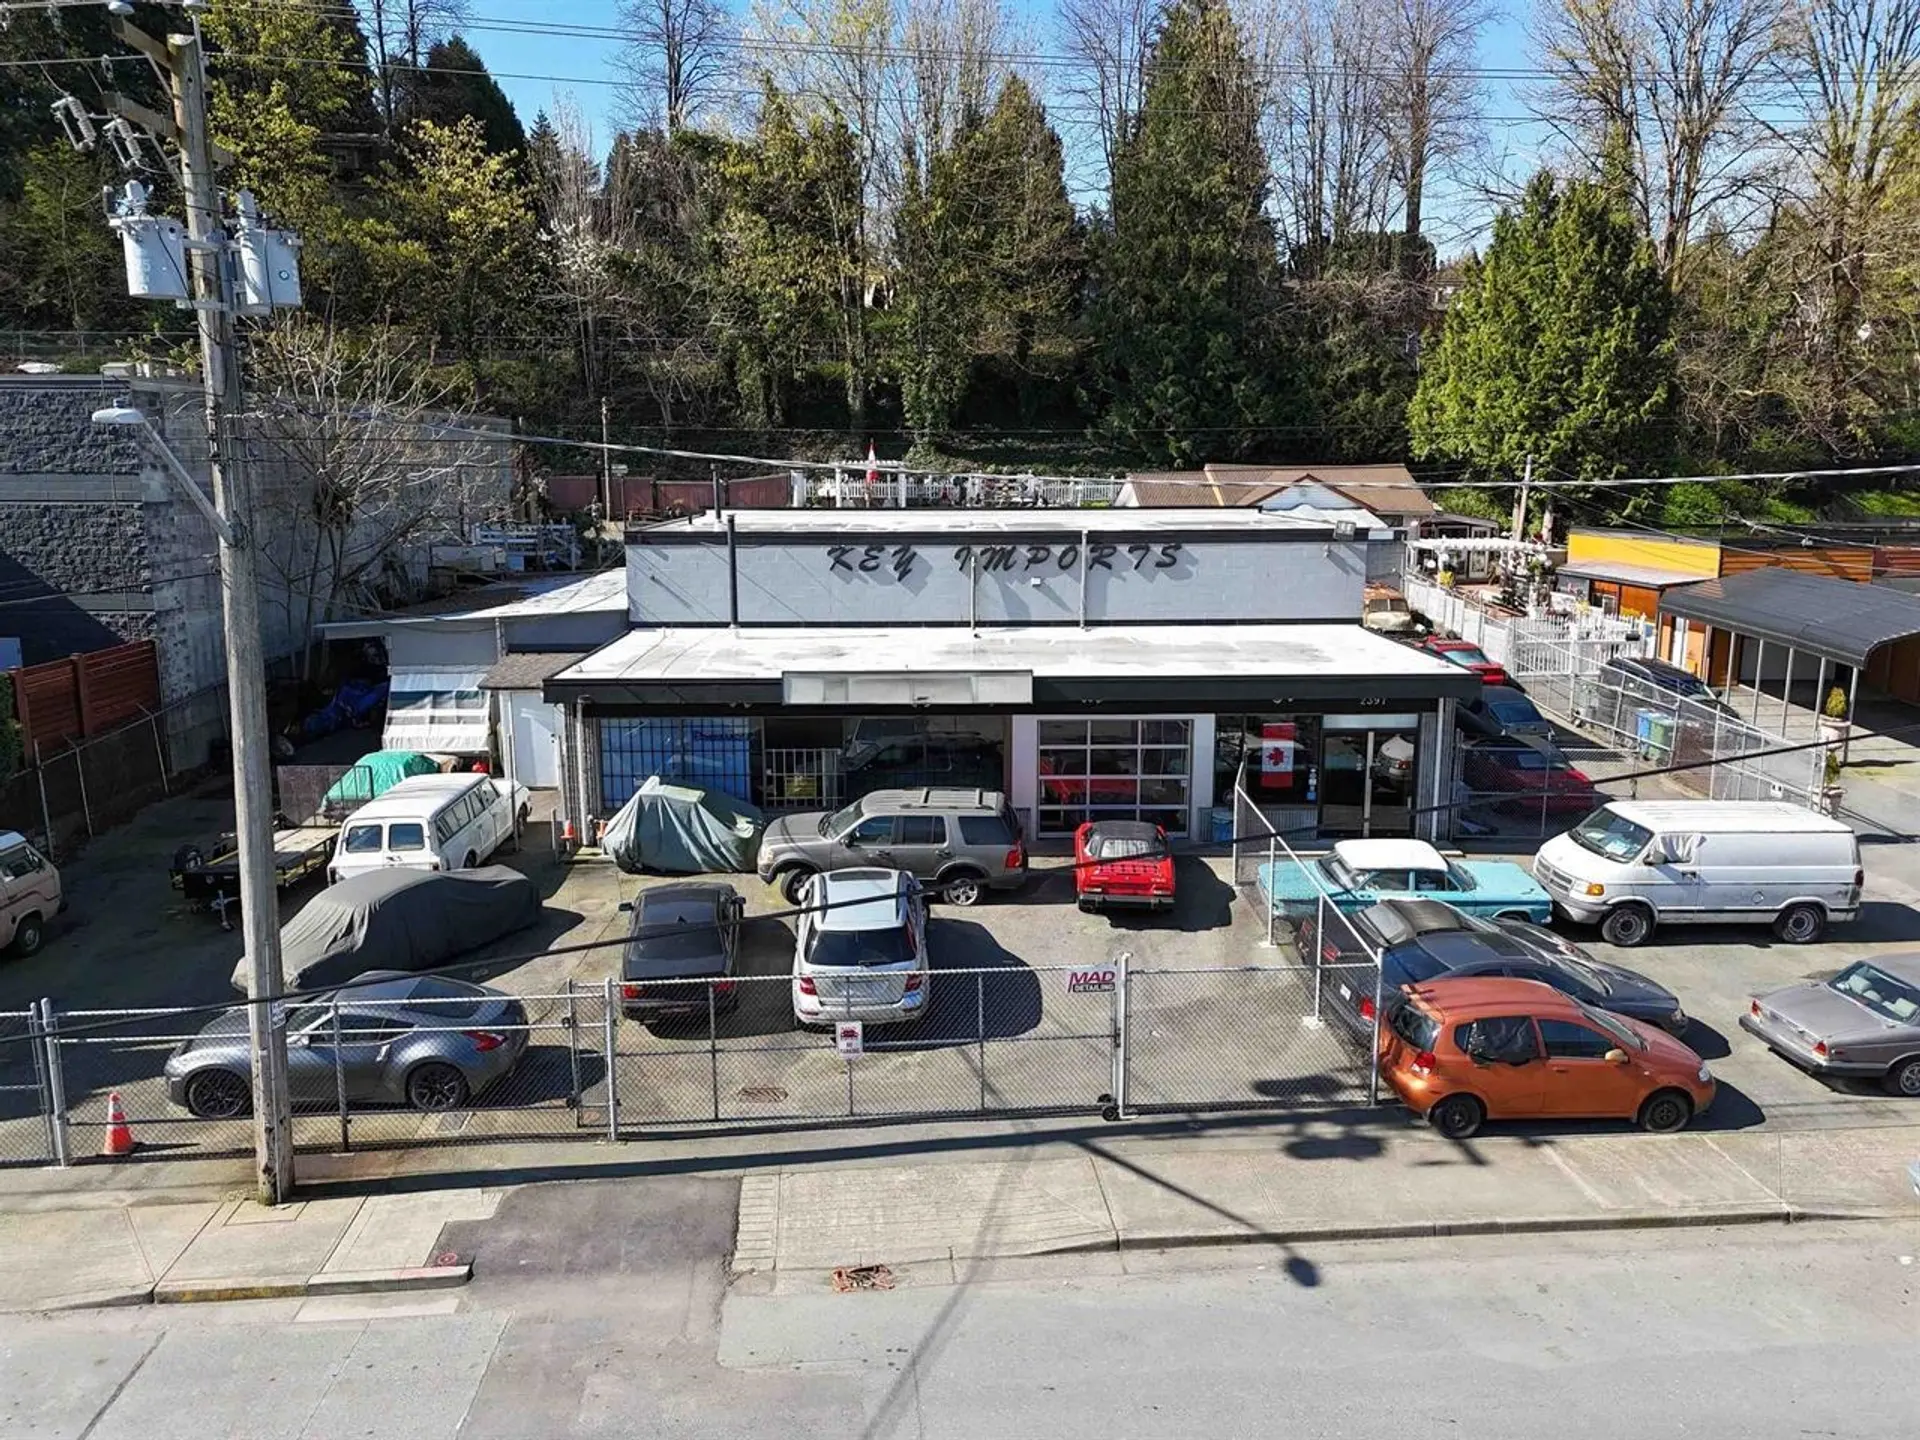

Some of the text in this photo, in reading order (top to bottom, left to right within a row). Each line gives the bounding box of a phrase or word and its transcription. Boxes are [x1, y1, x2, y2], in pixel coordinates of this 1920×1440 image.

[828, 545, 1181, 581] KEY IMPORTS
[1068, 971, 1115, 993] MAD
